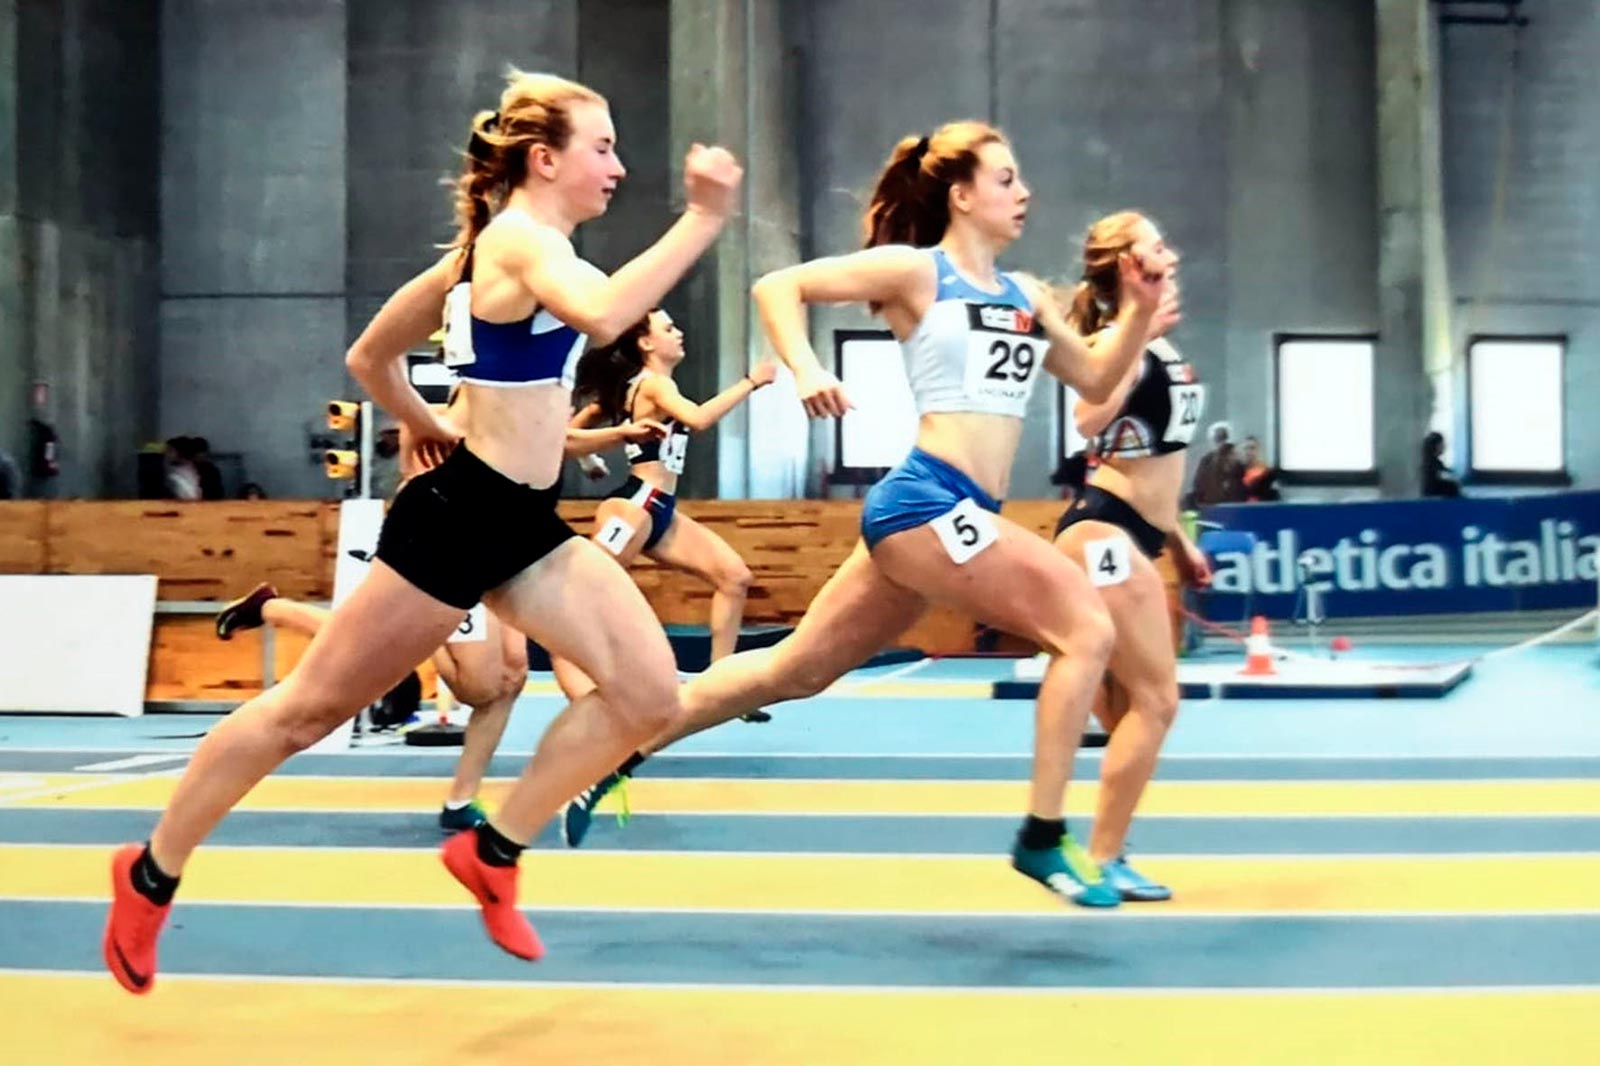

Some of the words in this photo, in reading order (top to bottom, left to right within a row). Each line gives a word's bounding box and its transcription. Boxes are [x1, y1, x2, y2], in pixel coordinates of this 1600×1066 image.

[984, 339, 1034, 383] 29
[609, 526, 621, 543] 1
[953, 514, 979, 546] 5
[1099, 548, 1116, 575] 4
[1211, 528, 1447, 593] atletica
